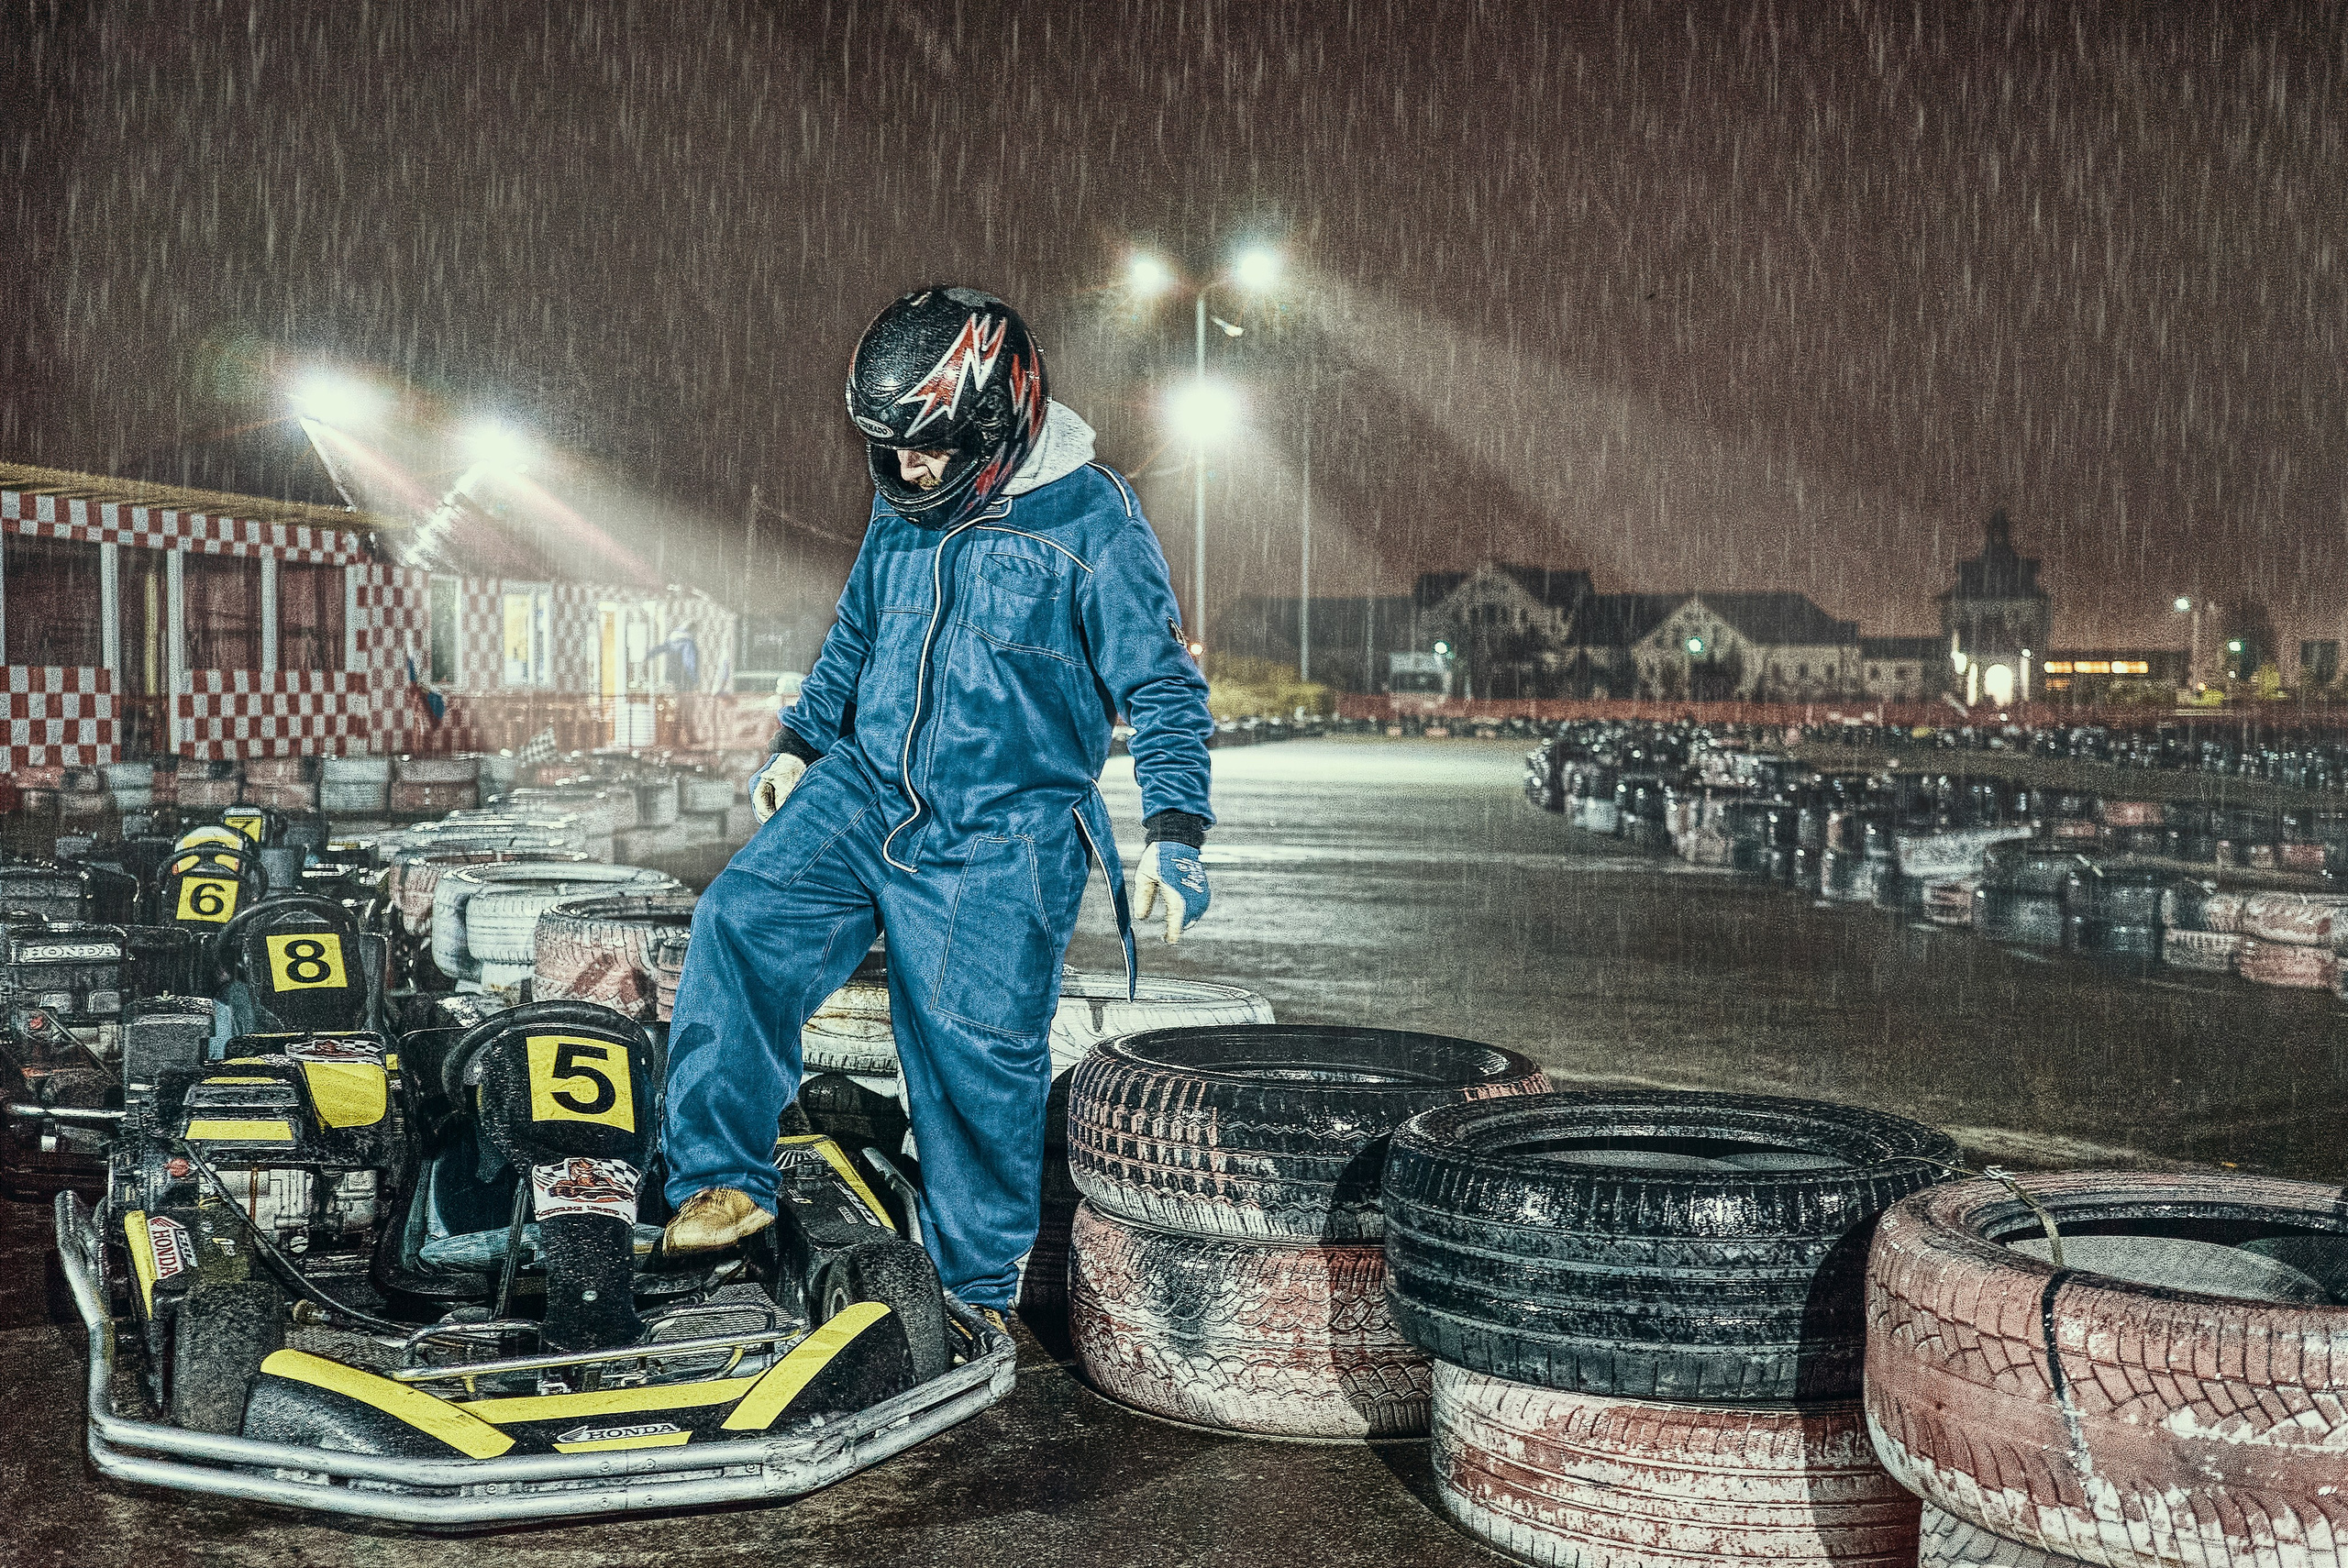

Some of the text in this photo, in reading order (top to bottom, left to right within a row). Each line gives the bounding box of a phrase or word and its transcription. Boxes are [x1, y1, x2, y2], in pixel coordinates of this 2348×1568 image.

[189, 883, 225, 916] 6
[24, 944, 121, 959] HONDA
[283, 939, 331, 984] 8
[550, 1043, 616, 1115] 5
[150, 1228, 179, 1278] HONDA
[588, 1422, 676, 1441] HONDA
